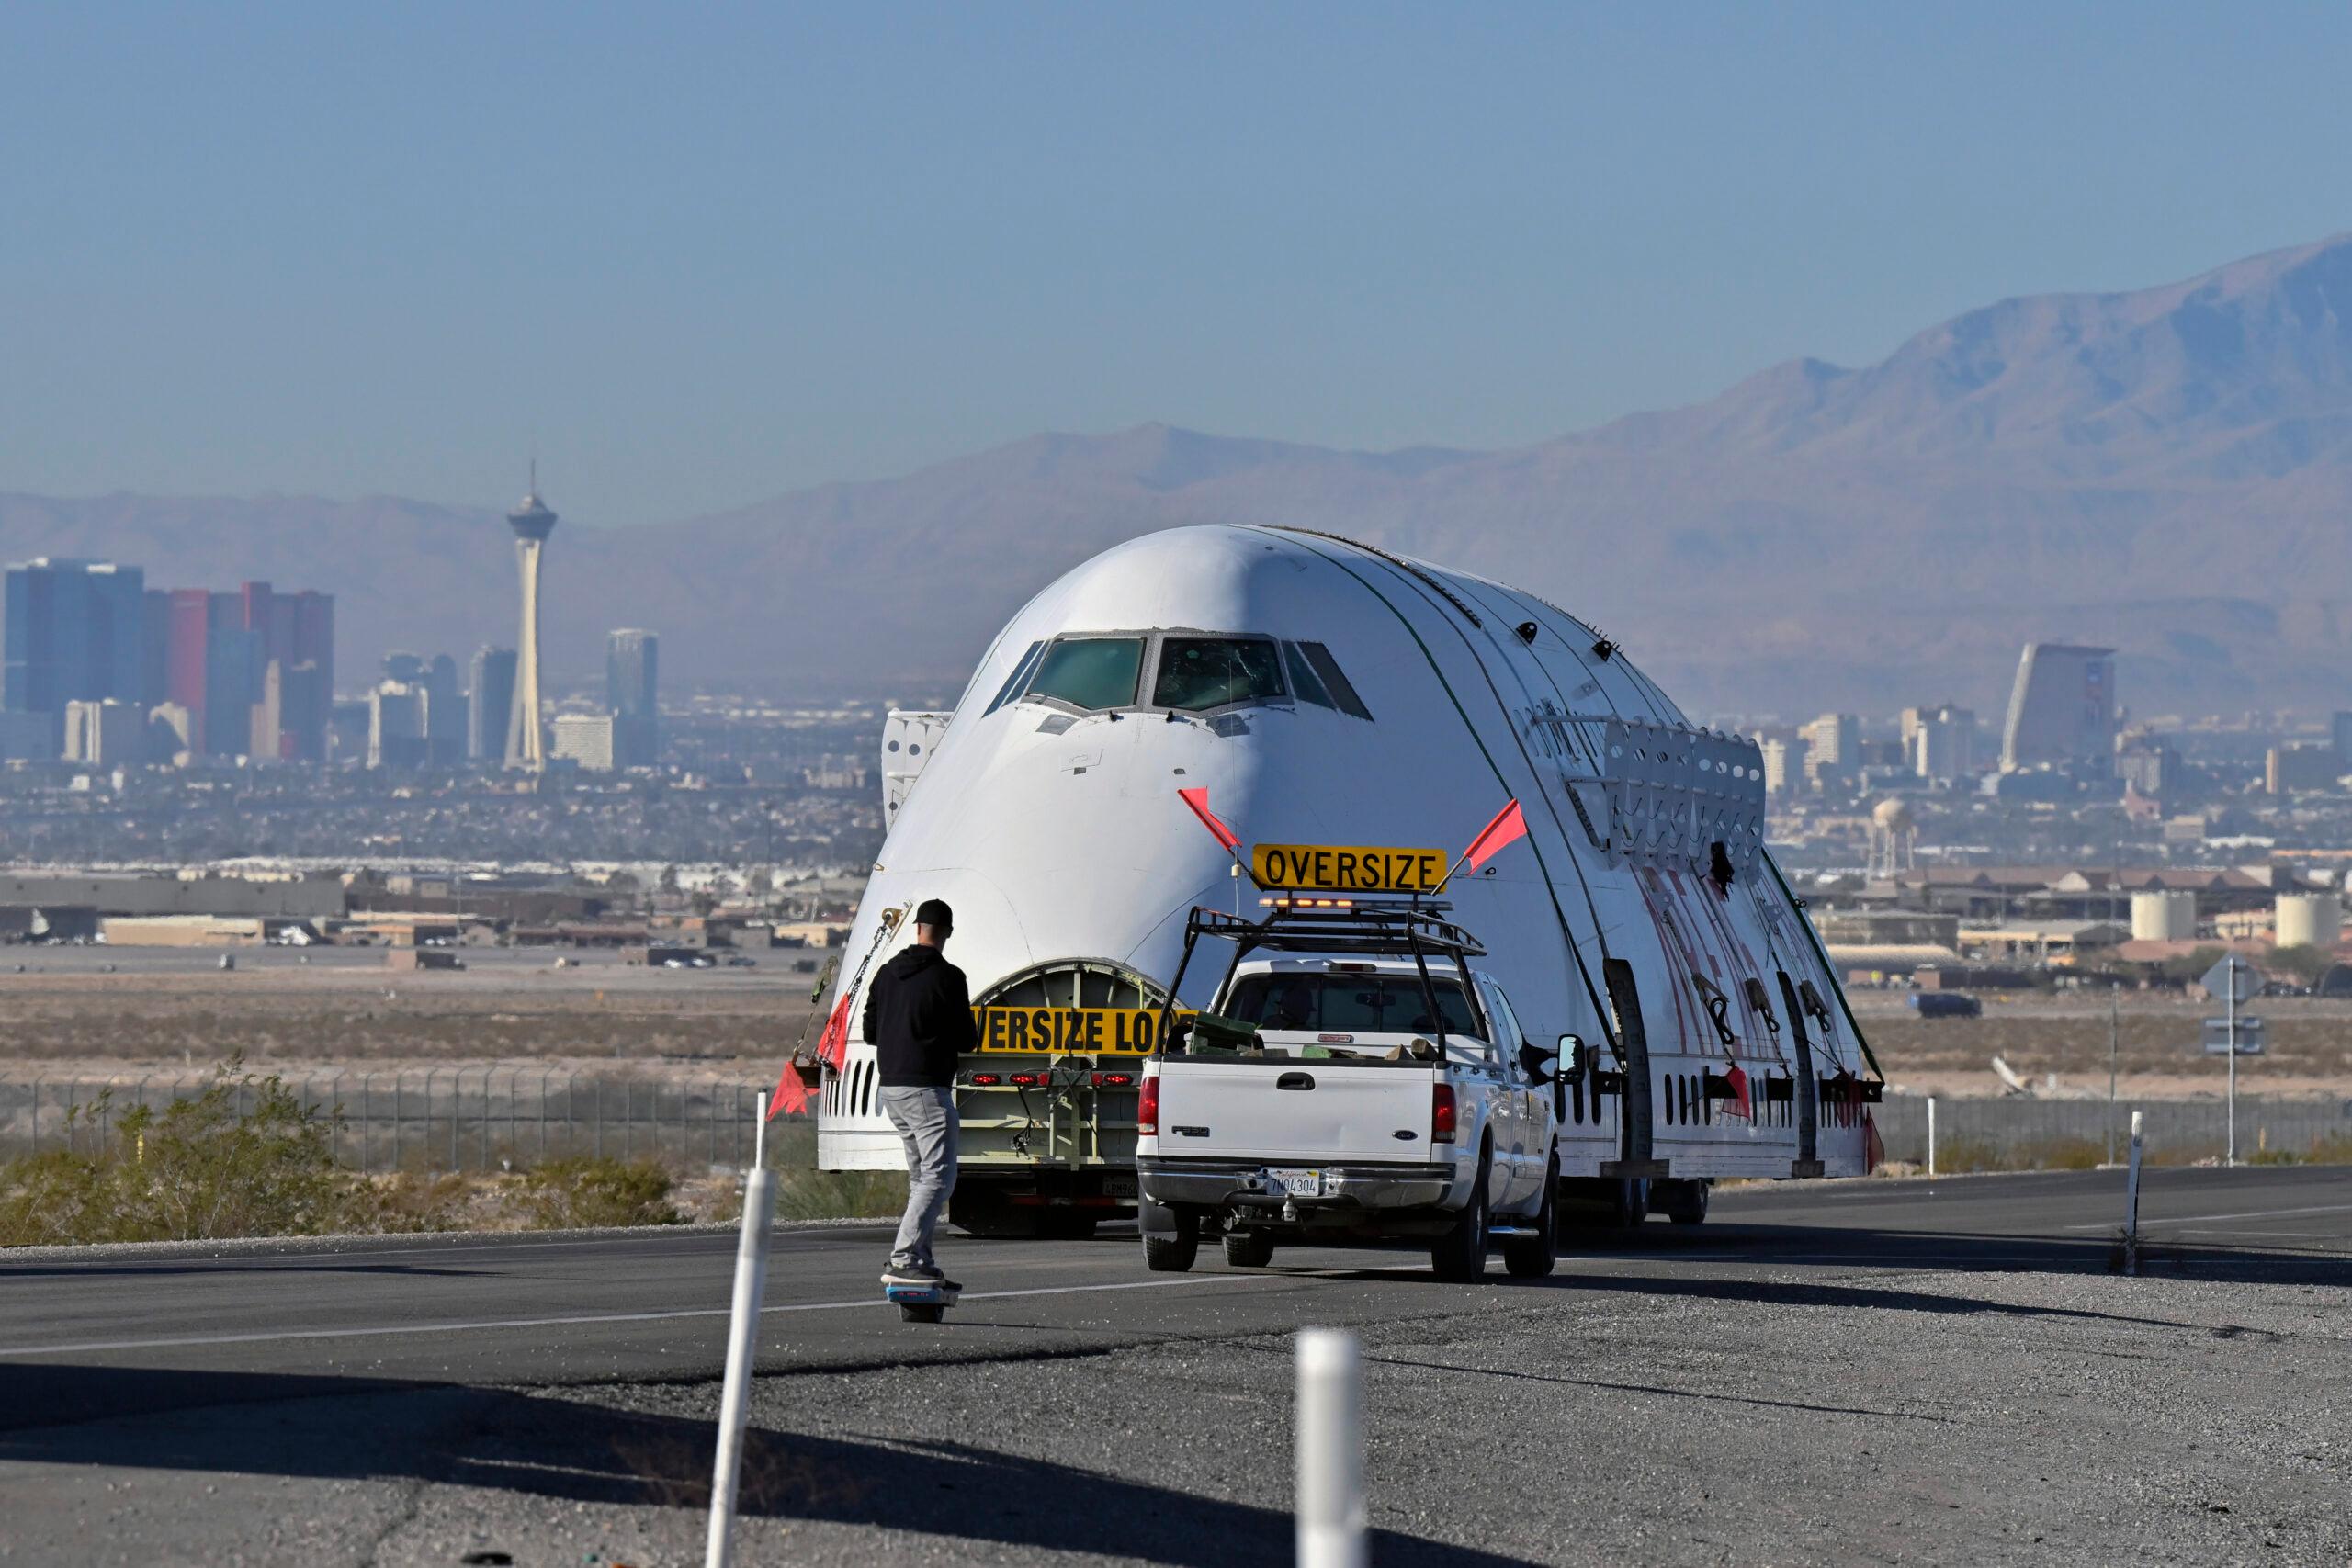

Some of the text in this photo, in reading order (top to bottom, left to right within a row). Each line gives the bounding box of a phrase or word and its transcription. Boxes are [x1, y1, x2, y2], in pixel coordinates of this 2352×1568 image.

[1265, 849, 1438, 888] OVERSIZE
[970, 1010, 1103, 1052] VERSIZE
[1271, 1179, 1316, 1192] 7N04304
